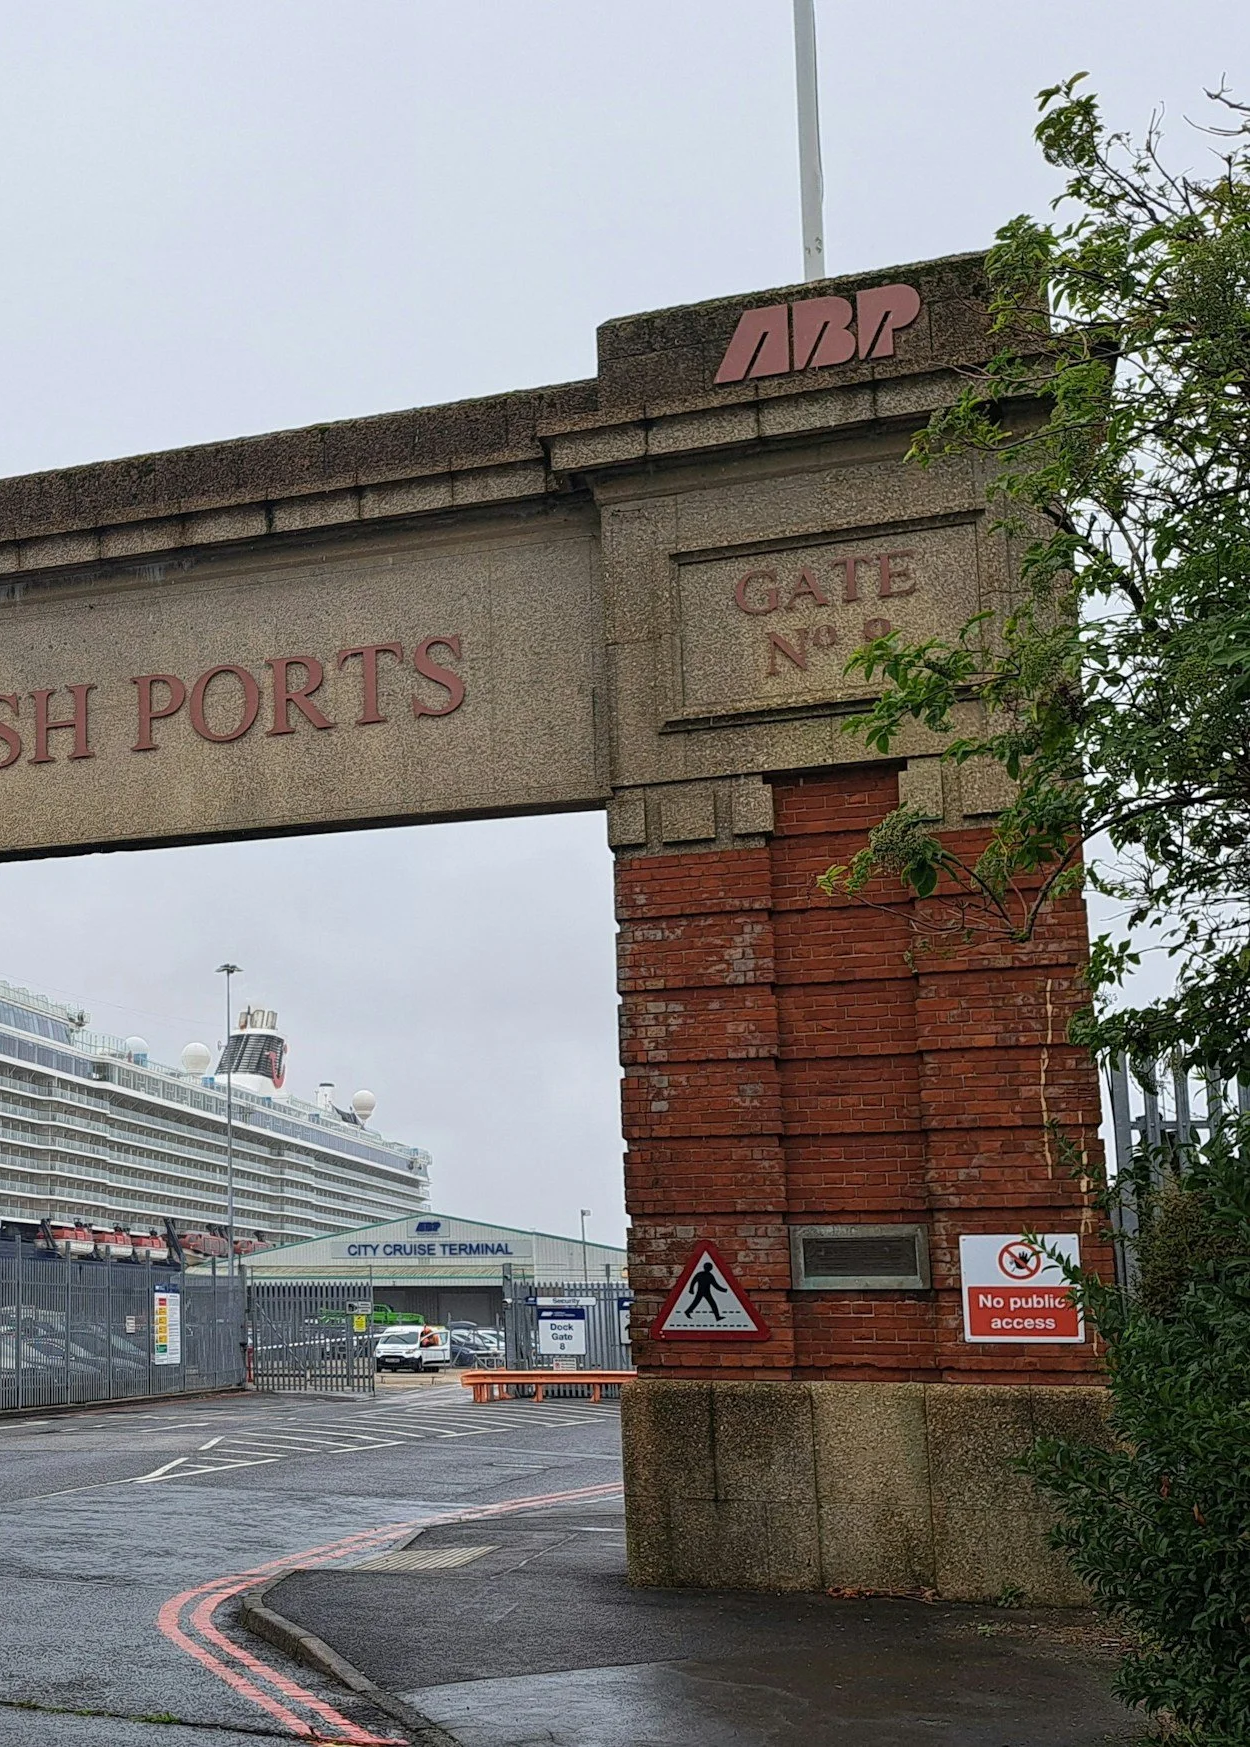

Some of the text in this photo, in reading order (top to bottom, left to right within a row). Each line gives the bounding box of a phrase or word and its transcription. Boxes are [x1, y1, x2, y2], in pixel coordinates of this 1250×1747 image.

[713, 283, 921, 385] ABP
[735, 550, 921, 616] GATE
[130, 633, 467, 754] PORTS
[348, 1242, 514, 1256] CITY CRUISE TERMINAL
[552, 1298, 581, 1306] Security
[978, 1294, 1066, 1312] No public
[991, 1318, 1056, 1330] access
[552, 1332, 573, 1340] Gate
